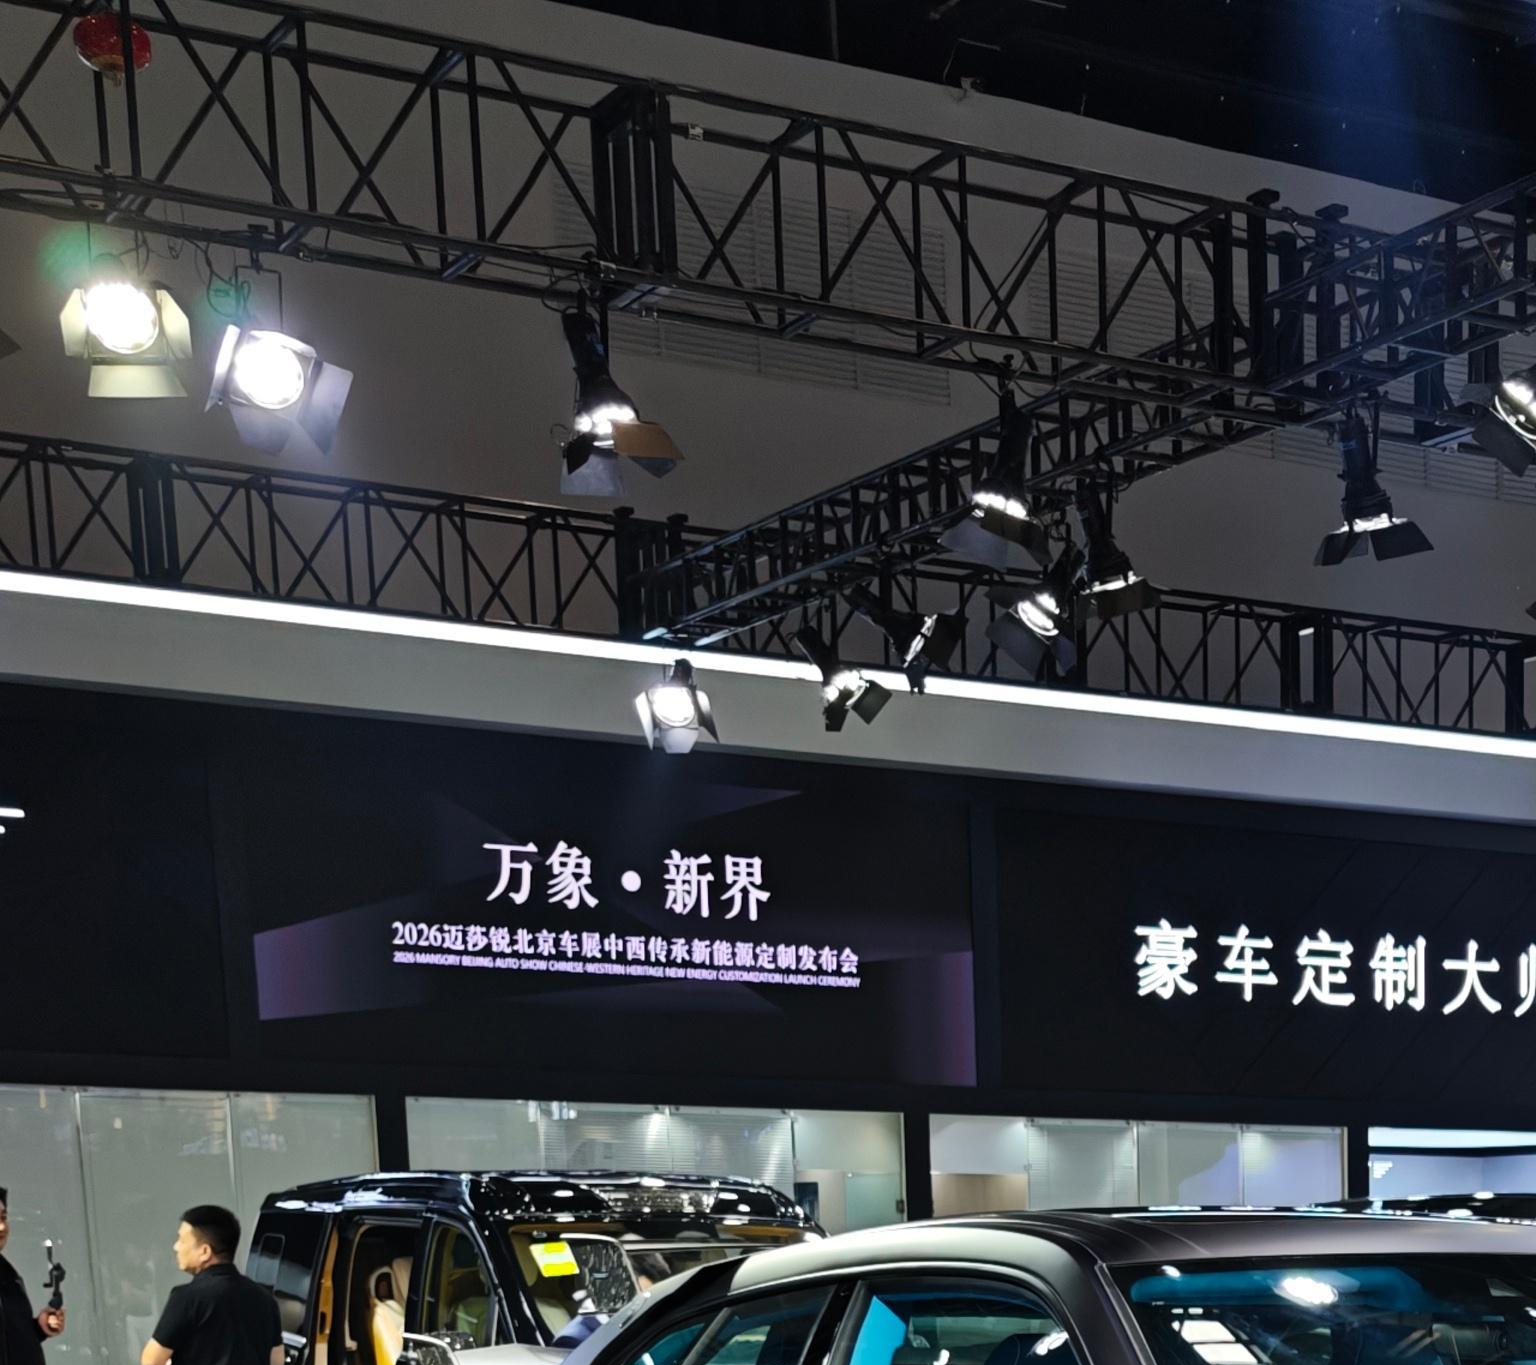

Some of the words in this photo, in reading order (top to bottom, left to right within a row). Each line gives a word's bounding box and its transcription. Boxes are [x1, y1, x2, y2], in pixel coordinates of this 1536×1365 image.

[416, 952, 461, 966] MANSORY
[495, 956, 519, 969] AUTO
[520, 958, 548, 971] SHOW
[665, 966, 686, 979] NEW
[784, 973, 817, 985] LAUNCH
